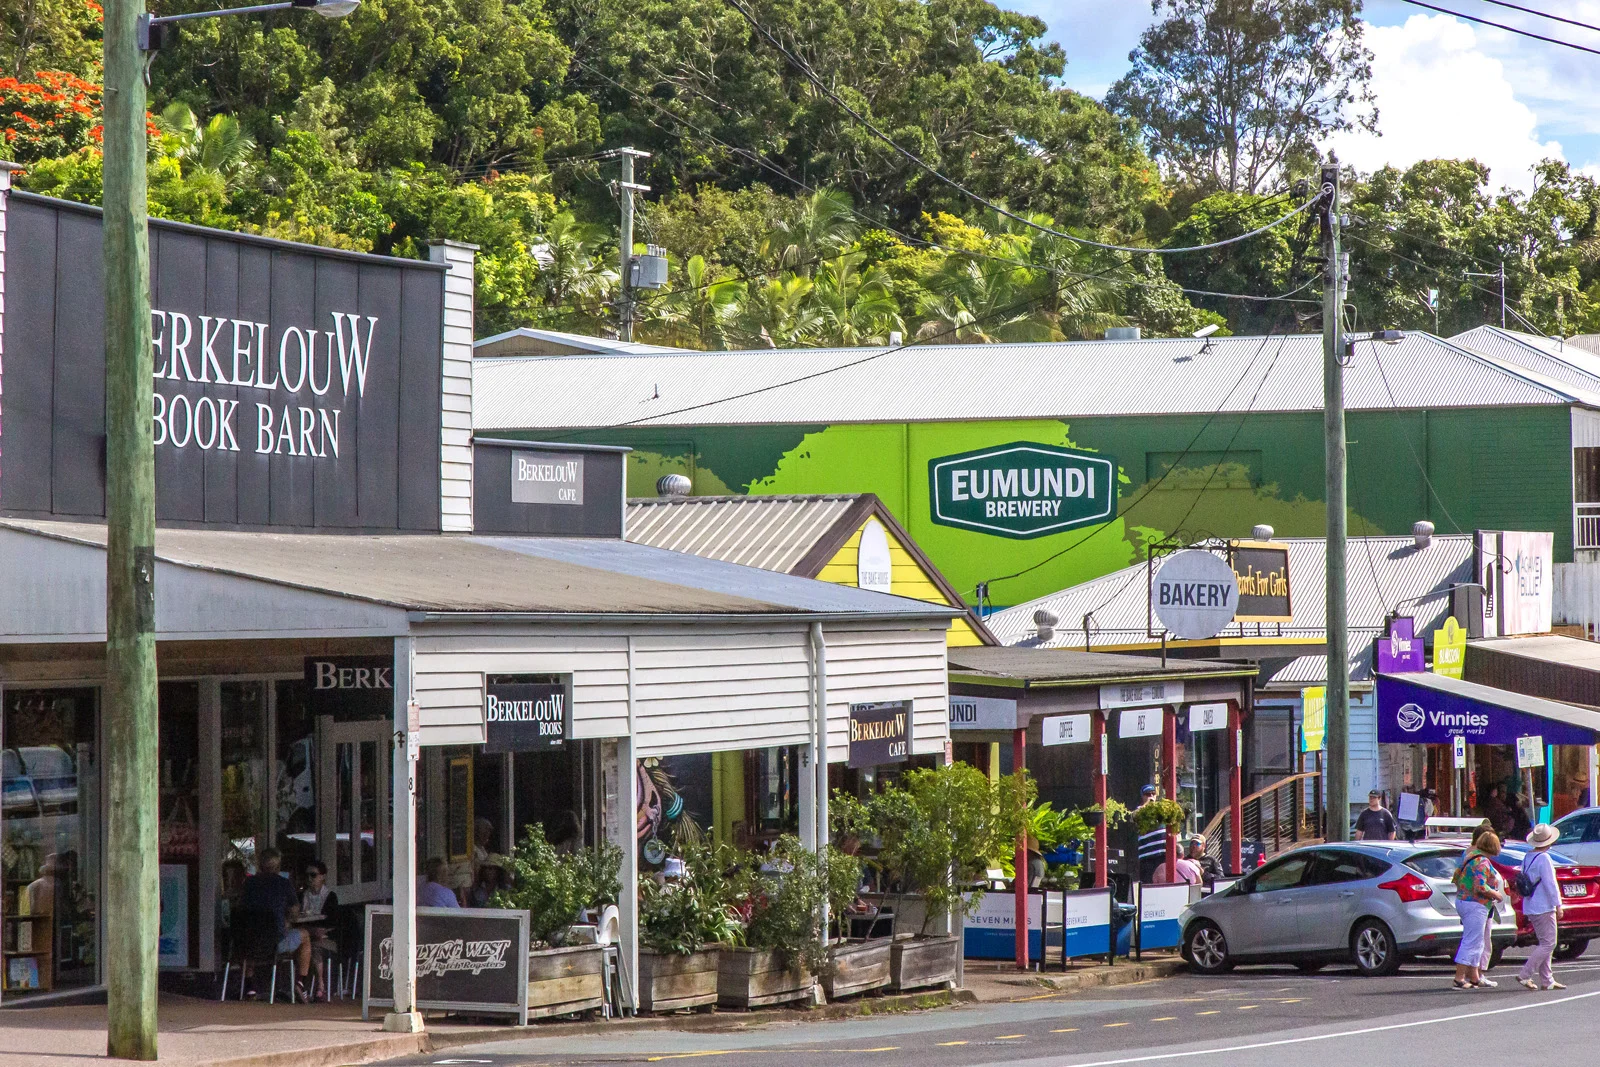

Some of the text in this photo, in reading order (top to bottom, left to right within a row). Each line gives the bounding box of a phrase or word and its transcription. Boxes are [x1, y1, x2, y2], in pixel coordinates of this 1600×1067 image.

[151, 310, 378, 398] ERKELOUW
[153, 393, 341, 458] BOOK BARN
[518, 458, 578, 482] BERKELOUW
[558, 488, 576, 501] CAFE
[952, 467, 1095, 501] EUMUNDI
[985, 500, 1062, 517] BREWERY
[1256, 570, 1268, 597] For
[1269, 567, 1288, 597] Girls
[1160, 583, 1231, 606] BAKERY
[314, 661, 392, 690] BERK
[486, 694, 564, 721] BERKELOUW
[949, 704, 976, 722] UNDI
[1429, 711, 1489, 726] Vinnies
[540, 722, 562, 735] BOOKS
[851, 713, 906, 741] BERKELOUW
[1445, 727, 1464, 737] good
[888, 741, 906, 757] CAFE
[970, 915, 1032, 925] SEVEN MIS
